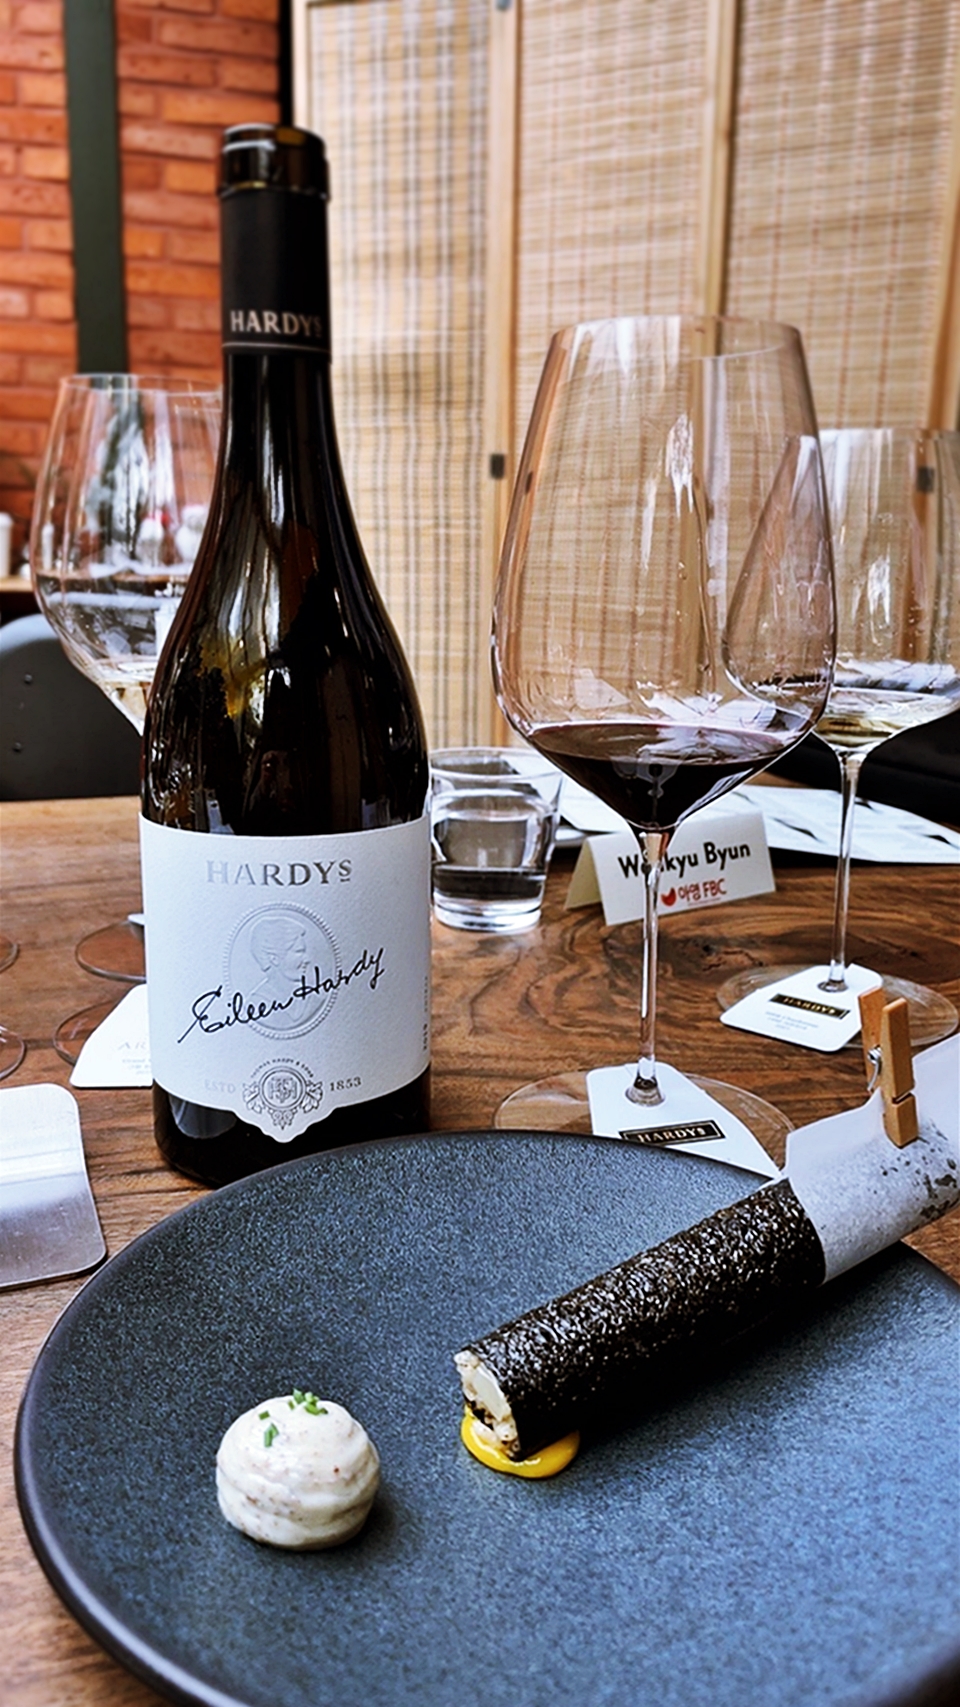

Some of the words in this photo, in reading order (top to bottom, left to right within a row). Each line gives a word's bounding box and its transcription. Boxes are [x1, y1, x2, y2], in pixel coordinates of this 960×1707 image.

[703, 841, 751, 871] Byun
[206, 858, 353, 887] HARDYS
[703, 878, 727, 898] FBC
[177, 985, 294, 1044] Eileen
[292, 947, 386, 1000] Hardy
[203, 1078, 237, 1094] ESTD
[329, 1076, 363, 1092] 1853
